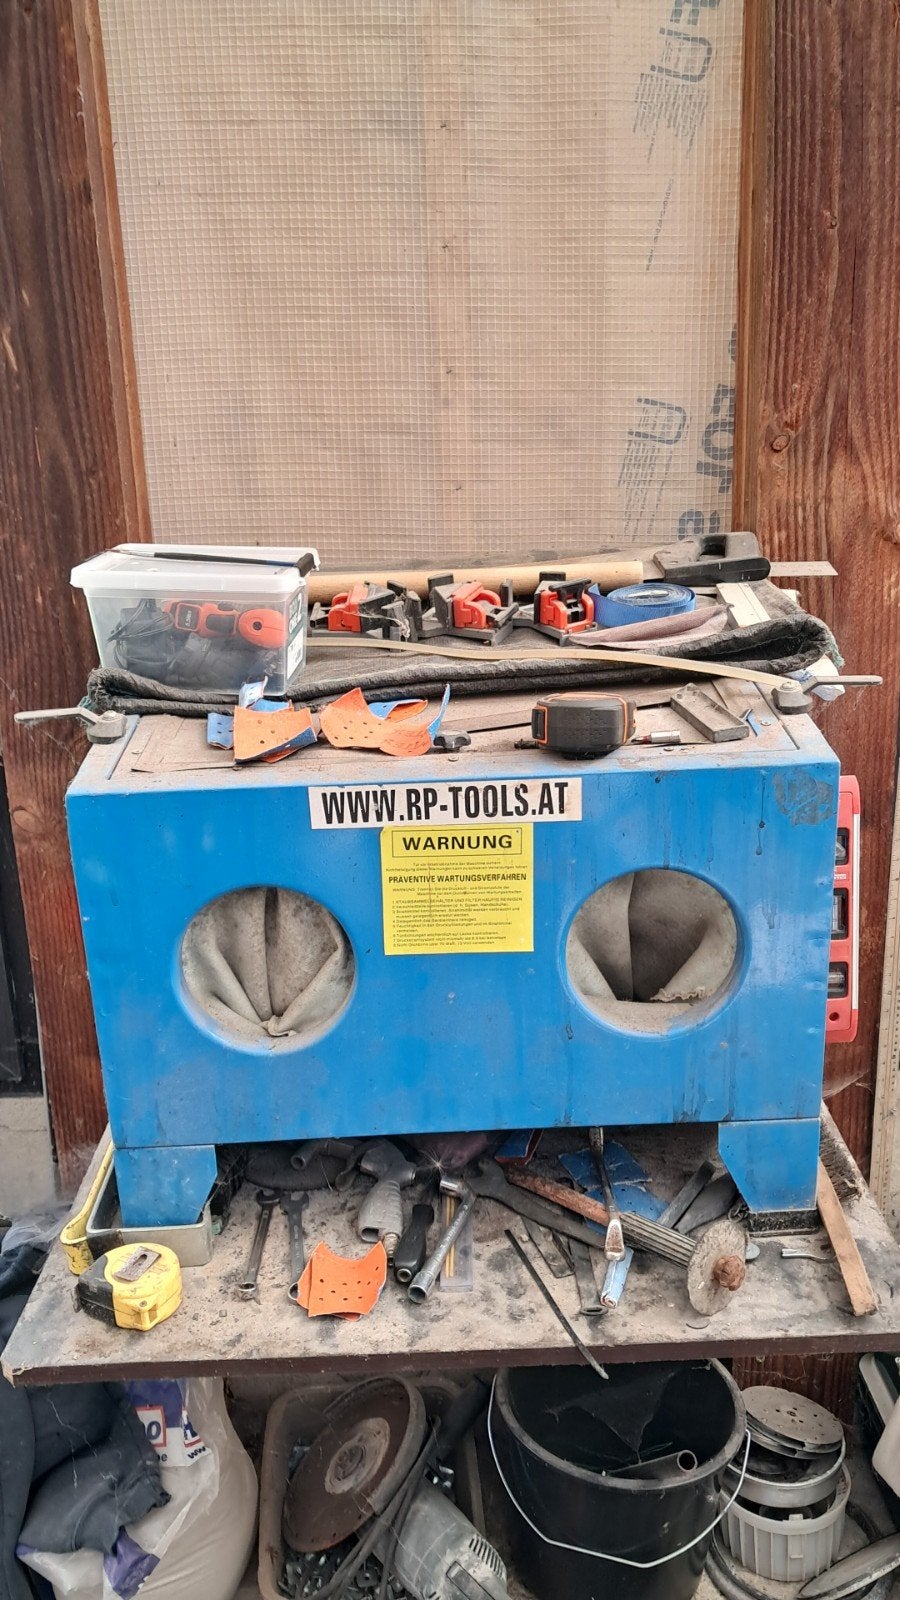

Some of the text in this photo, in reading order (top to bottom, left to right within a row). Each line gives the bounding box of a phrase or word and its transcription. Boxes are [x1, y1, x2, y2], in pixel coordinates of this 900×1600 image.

[321, 781, 569, 825] WWW.RP-TOOLS.AT
[402, 834, 512, 851] WARNUNG
[437, 872, 527, 882] WARTUNGSVERFAHREN
